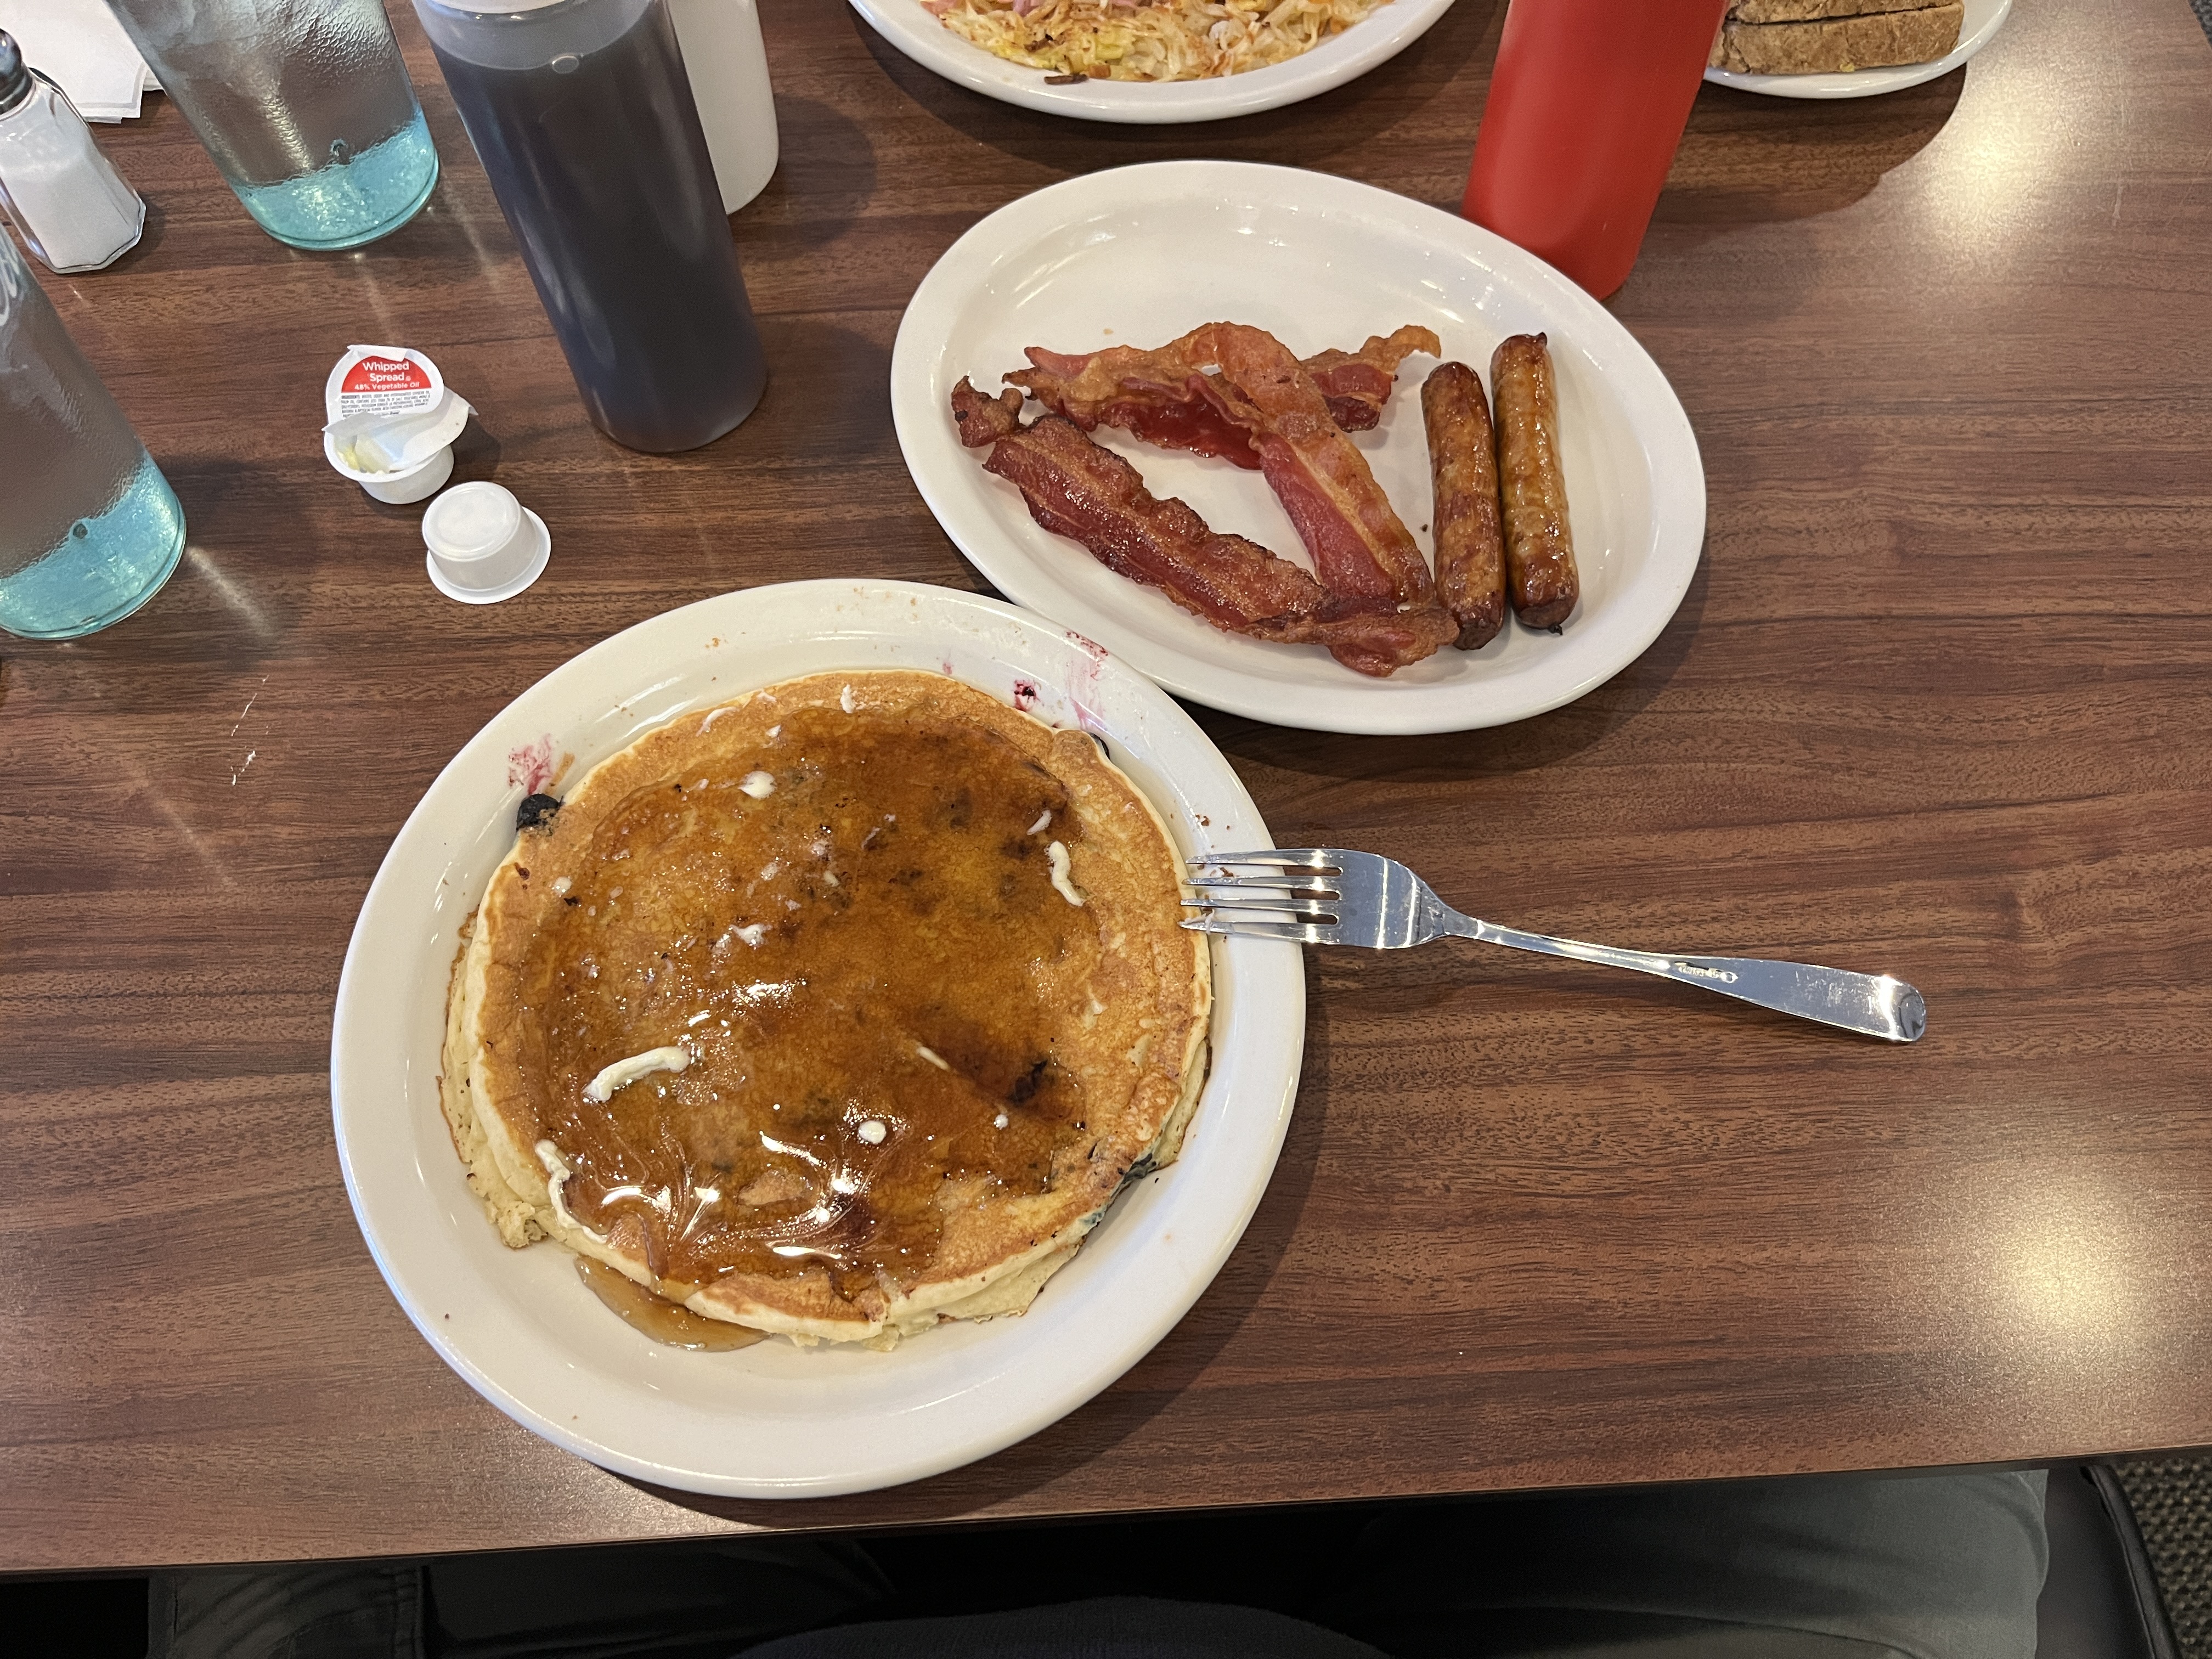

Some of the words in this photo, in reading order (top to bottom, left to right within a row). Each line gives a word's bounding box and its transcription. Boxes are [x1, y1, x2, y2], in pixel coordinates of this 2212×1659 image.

[362, 361, 410, 373] Whipped
[369, 372, 405, 383] Spread
[371, 382, 408, 391] Vegetable
